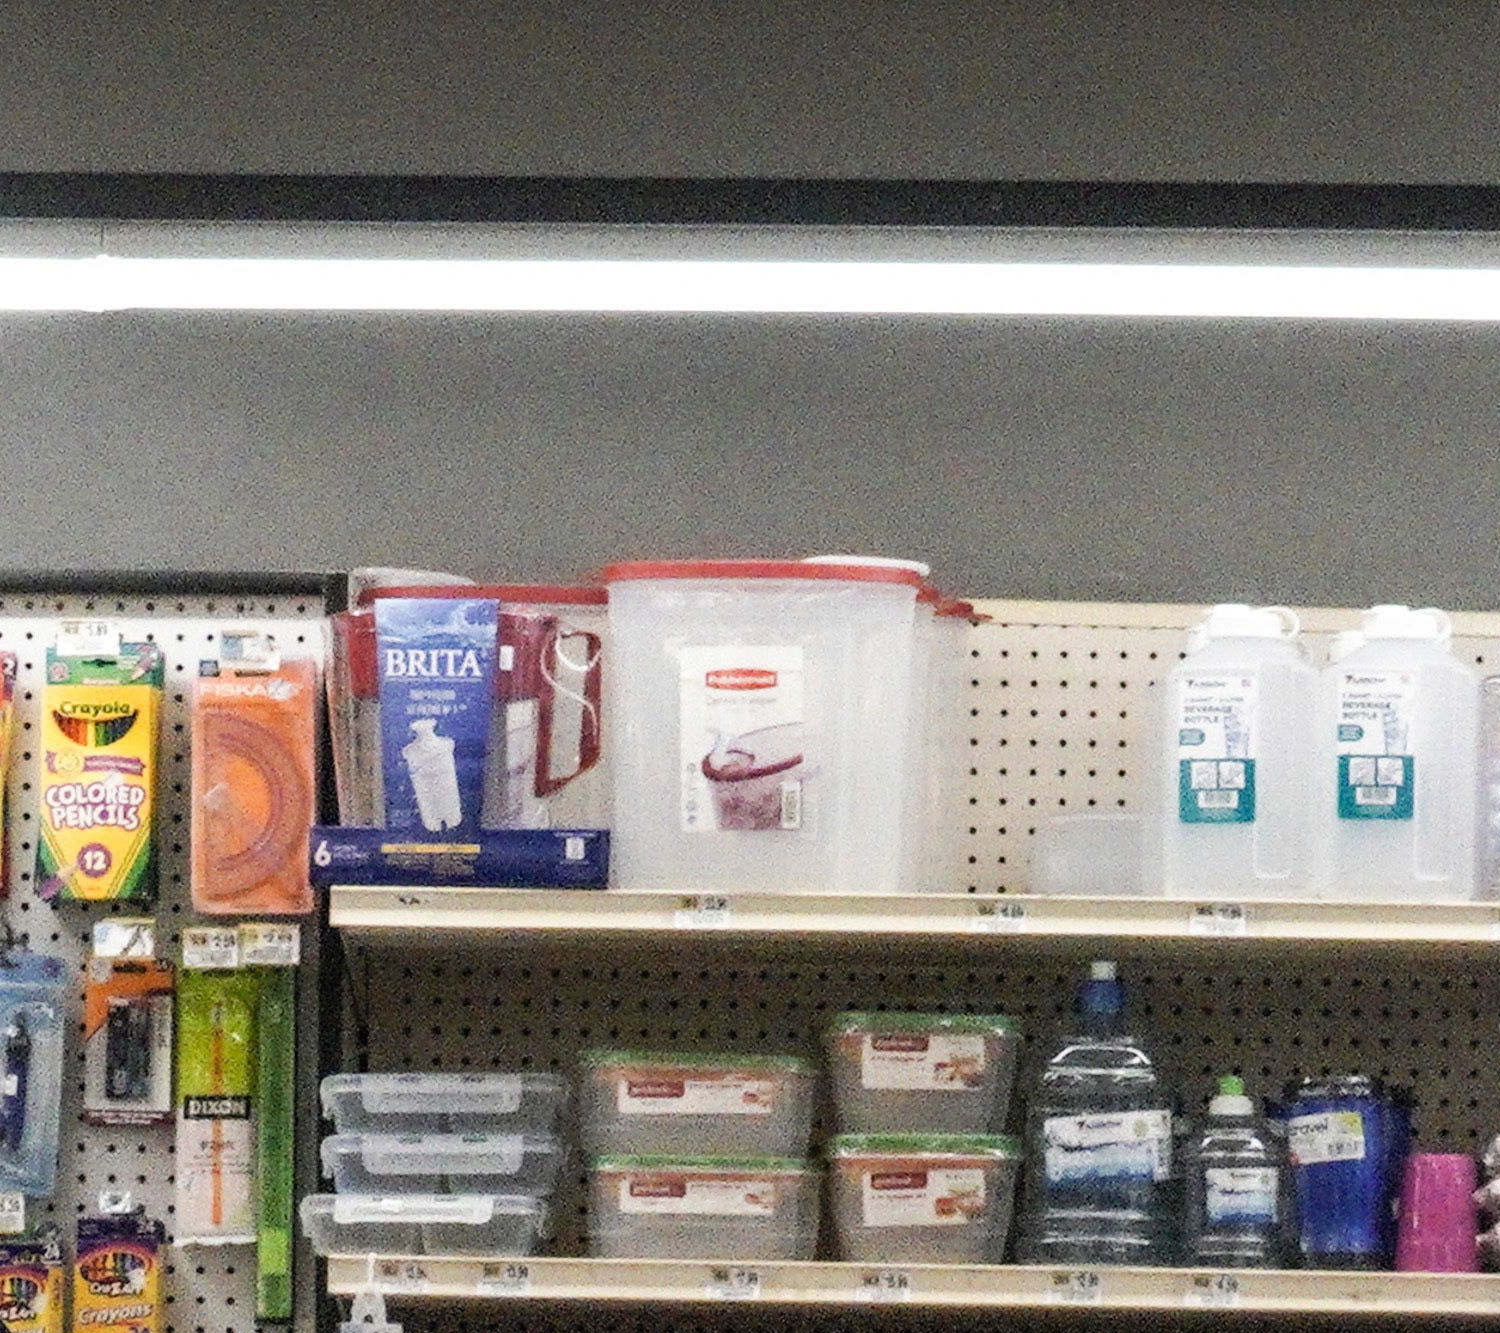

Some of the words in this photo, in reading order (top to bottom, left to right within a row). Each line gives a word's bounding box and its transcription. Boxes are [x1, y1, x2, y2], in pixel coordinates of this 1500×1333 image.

[385, 648, 483, 678] BRITA
[59, 700, 132, 717] Crayola
[46, 783, 146, 809] COLORED
[52, 806, 141, 831] PENCILS
[83, 849, 107, 871] 12
[314, 841, 332, 867] 6
[187, 1100, 247, 1116] DIXON
[79, 1305, 153, 1326] Crayons
